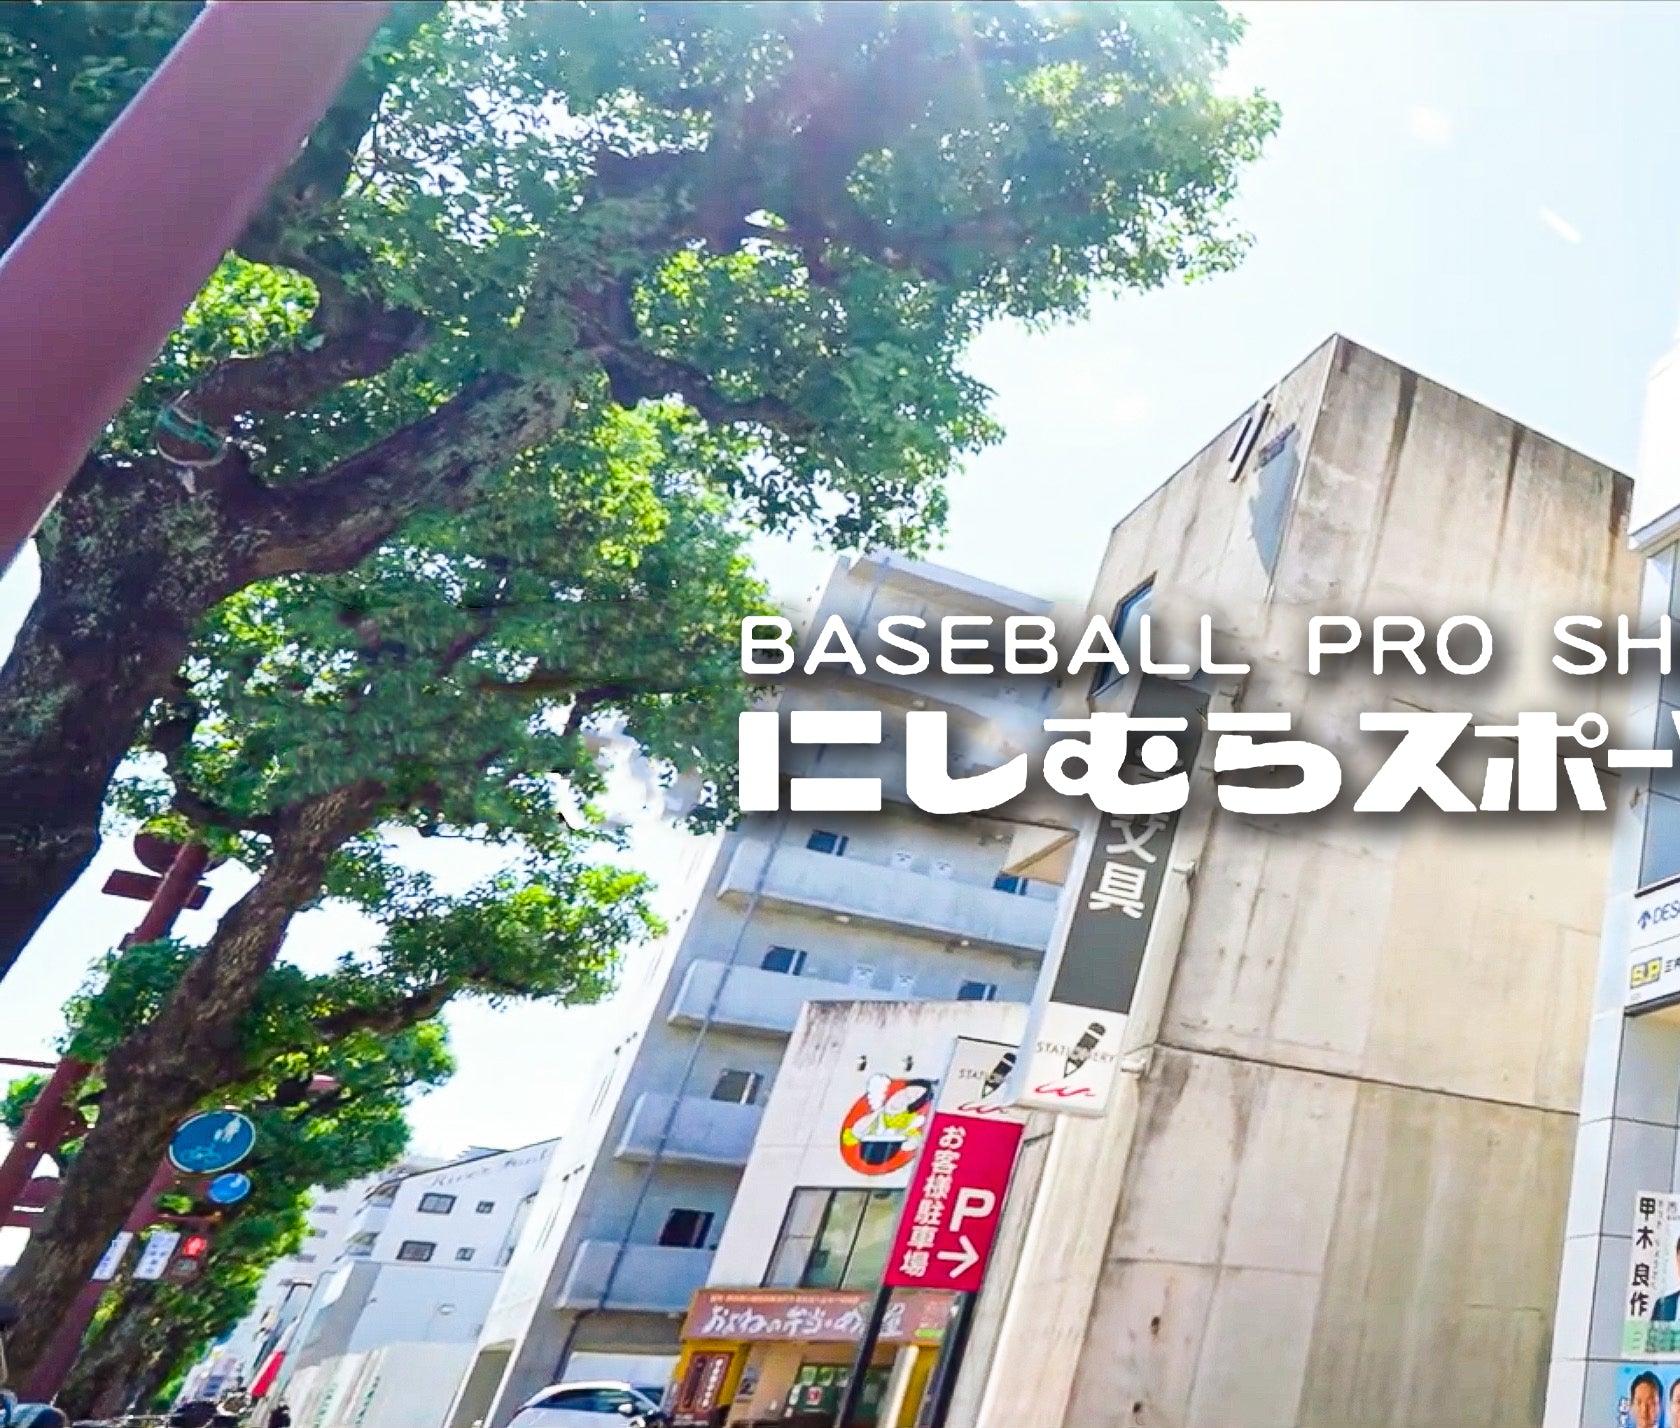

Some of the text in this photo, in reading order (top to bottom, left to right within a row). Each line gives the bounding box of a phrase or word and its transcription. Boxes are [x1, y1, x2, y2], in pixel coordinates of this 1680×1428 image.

[899, 1125, 964, 1278] お客様駐車場
[949, 1187, 995, 1233] P
